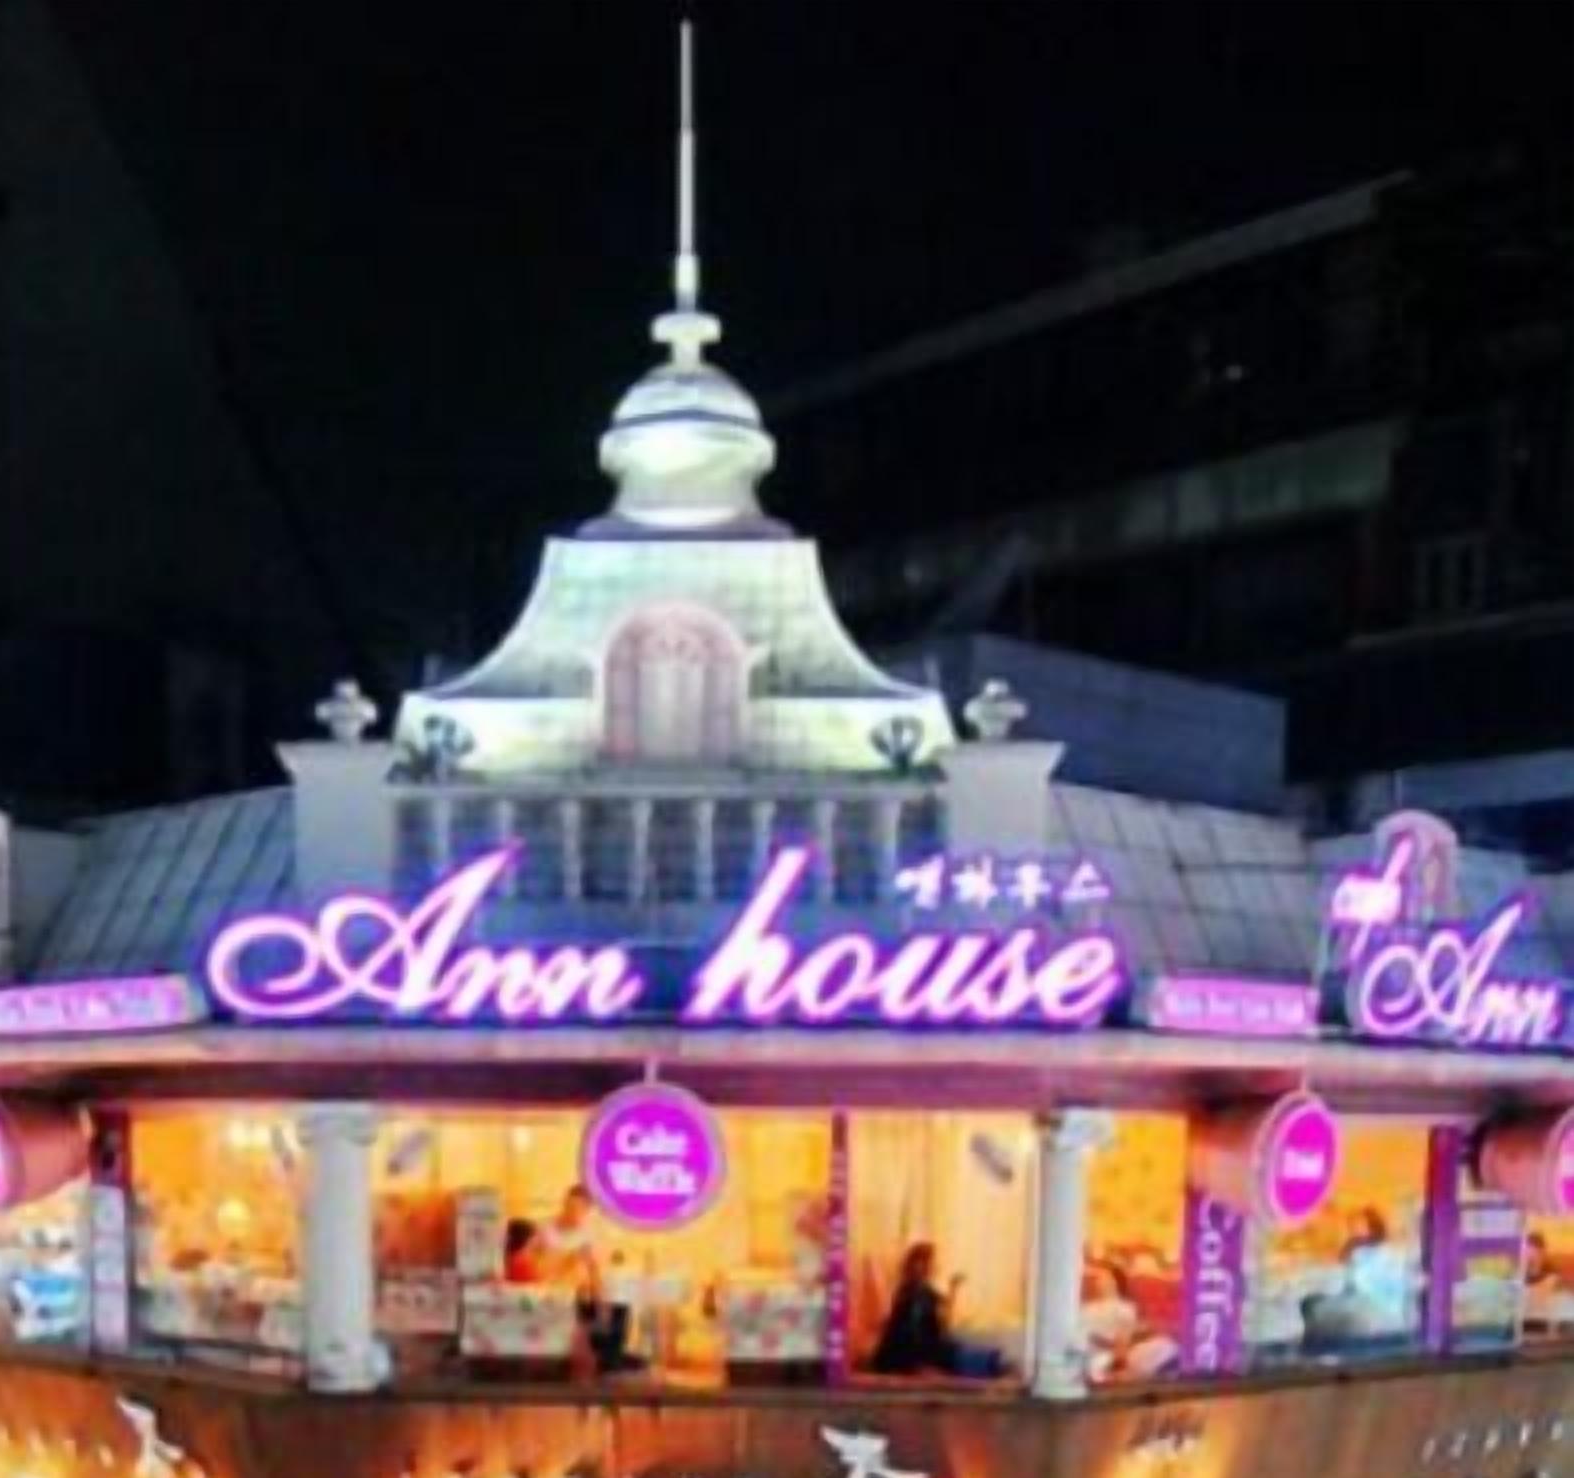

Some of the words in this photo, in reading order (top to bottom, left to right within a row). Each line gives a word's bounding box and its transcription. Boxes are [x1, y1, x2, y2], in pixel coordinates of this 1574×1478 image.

[209, 838, 646, 1018] Ann
[680, 846, 1118, 1022] house
[1360, 896, 1560, 1042] Ann
